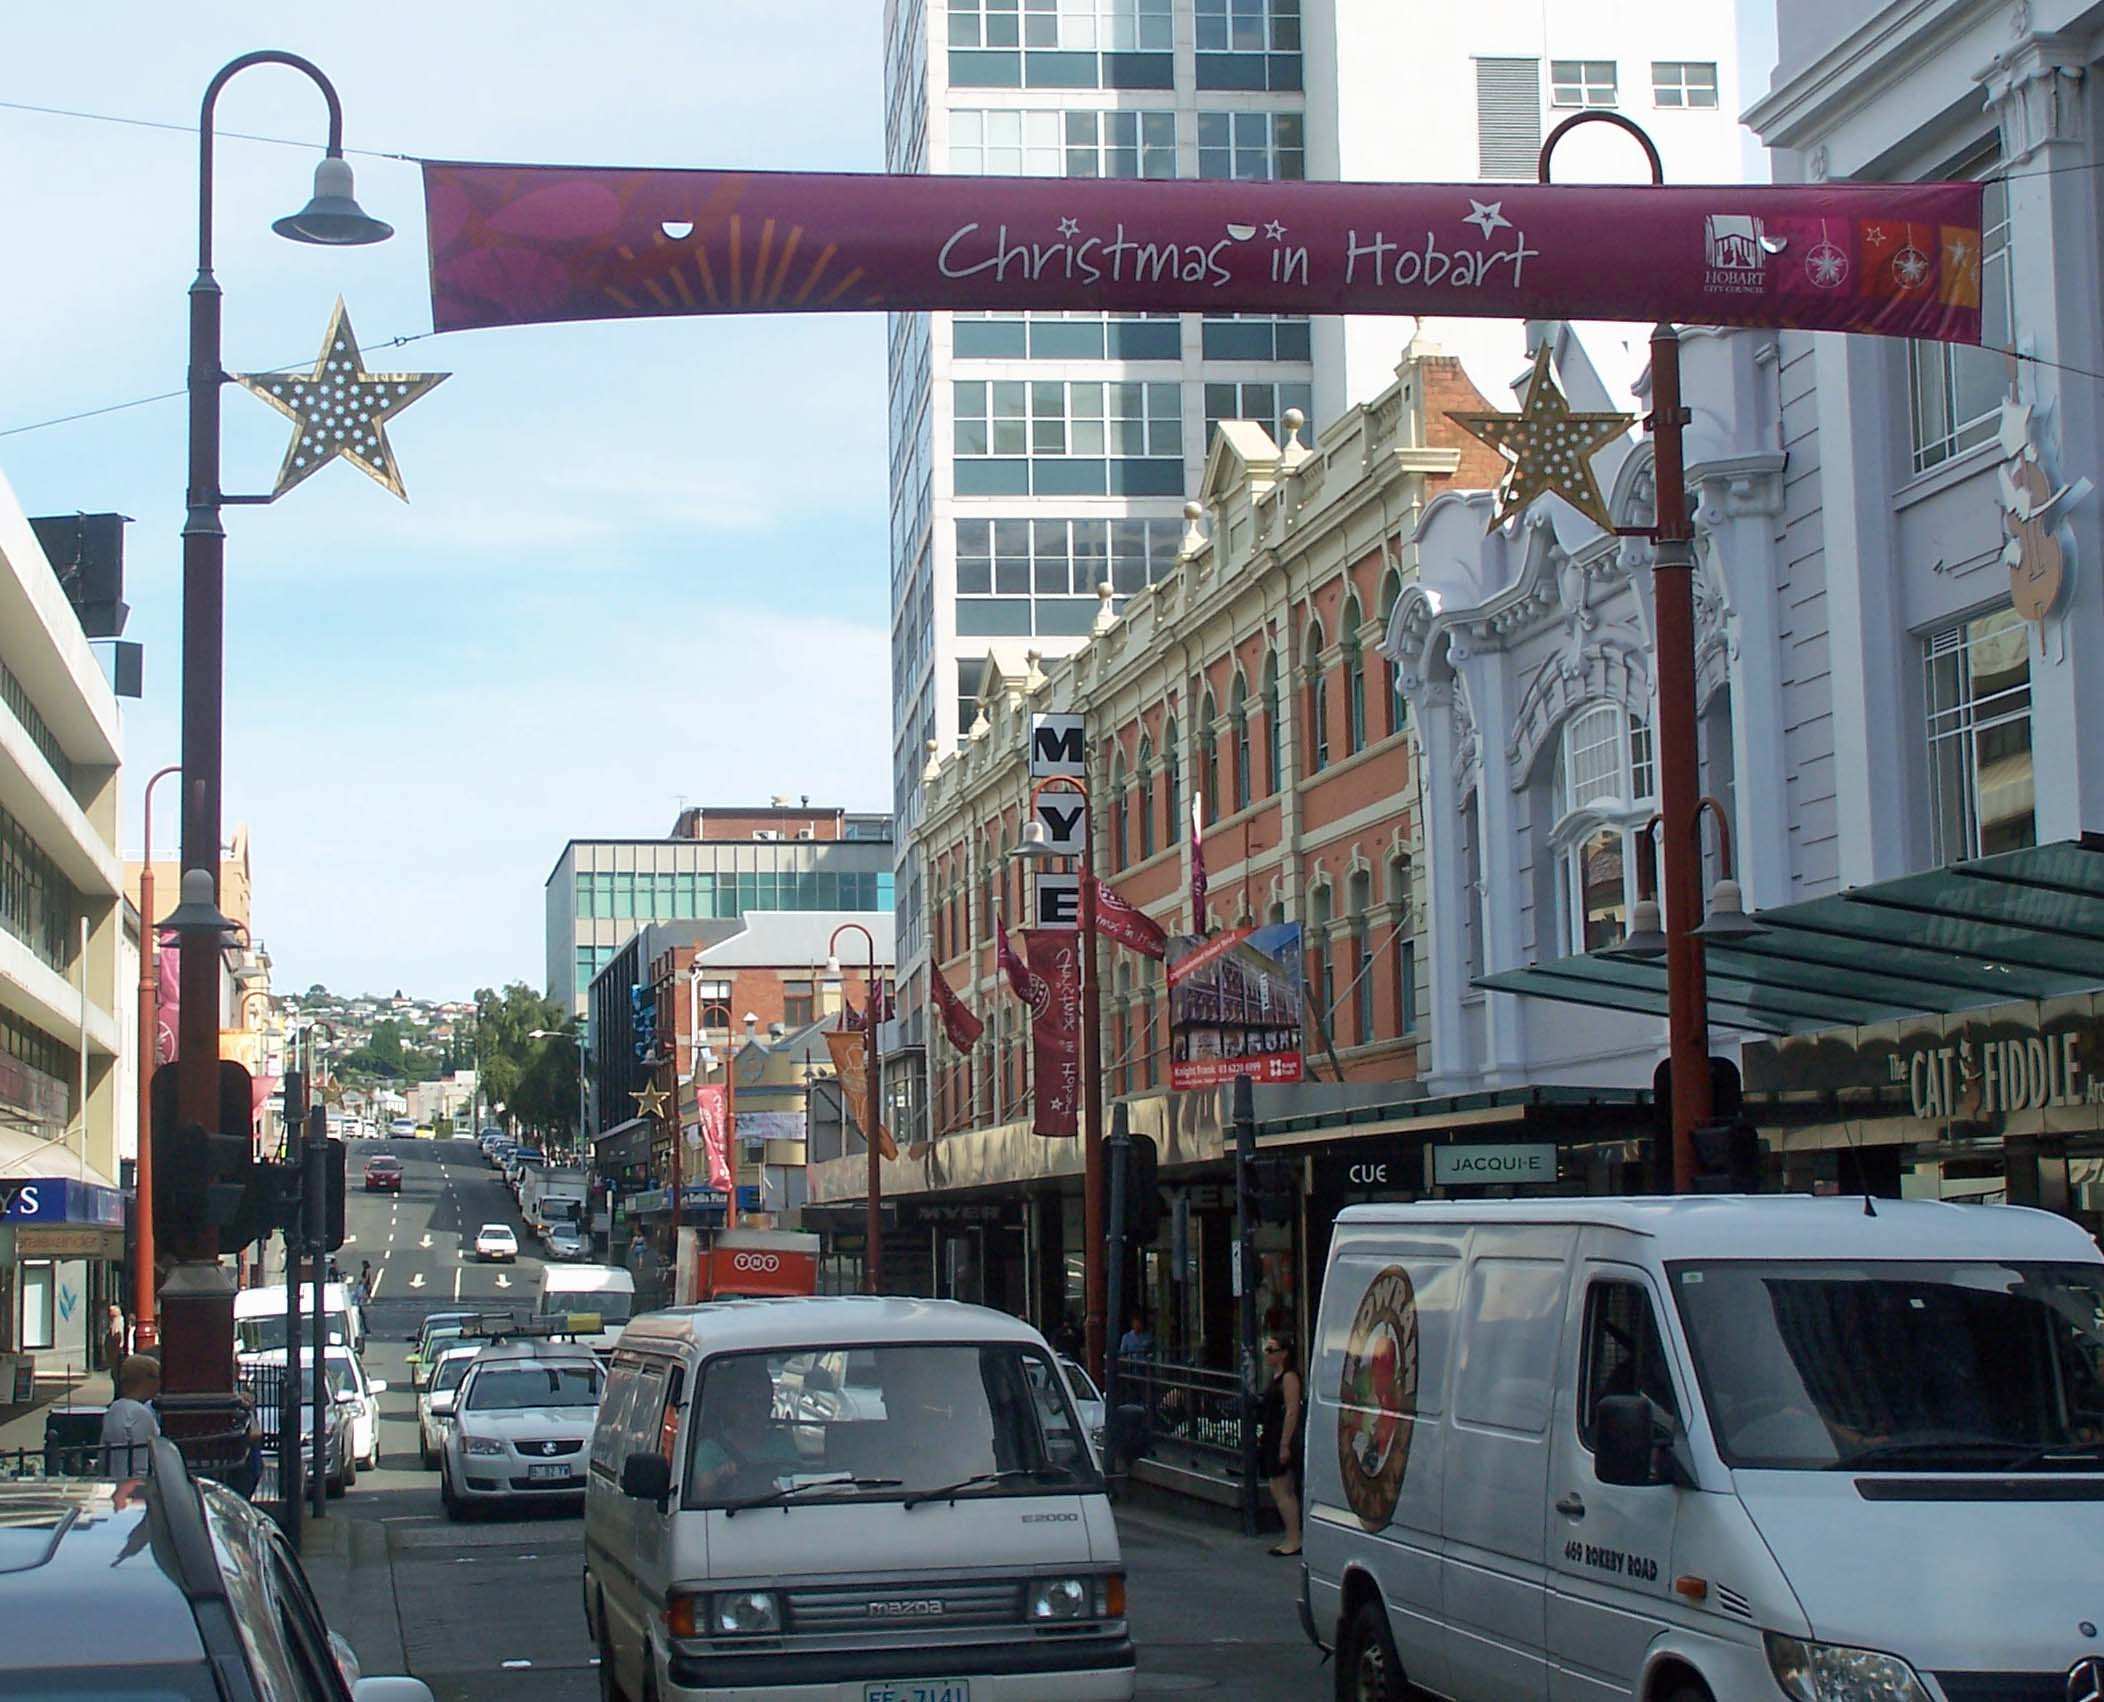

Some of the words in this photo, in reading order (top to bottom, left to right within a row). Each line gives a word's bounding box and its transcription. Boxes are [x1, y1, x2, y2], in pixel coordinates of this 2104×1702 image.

[938, 216, 1232, 287] Christmas
[1267, 224, 1309, 285] in
[1345, 229, 1539, 288] Hobart
[1704, 271, 1766, 286] HOBART
[1887, 1053, 1908, 1081] The
[1910, 1047, 1956, 1119] CAT
[1983, 1031, 2082, 1113] FIDDLE
[1349, 1164, 1388, 1183] CUE
[737, 1255, 777, 1270] TNT
[1022, 1513, 1078, 1523] E2000
[1564, 1540, 1583, 1562] 469
[1627, 1554, 1658, 1581] ROAD
[868, 1600, 943, 1616] mazda
